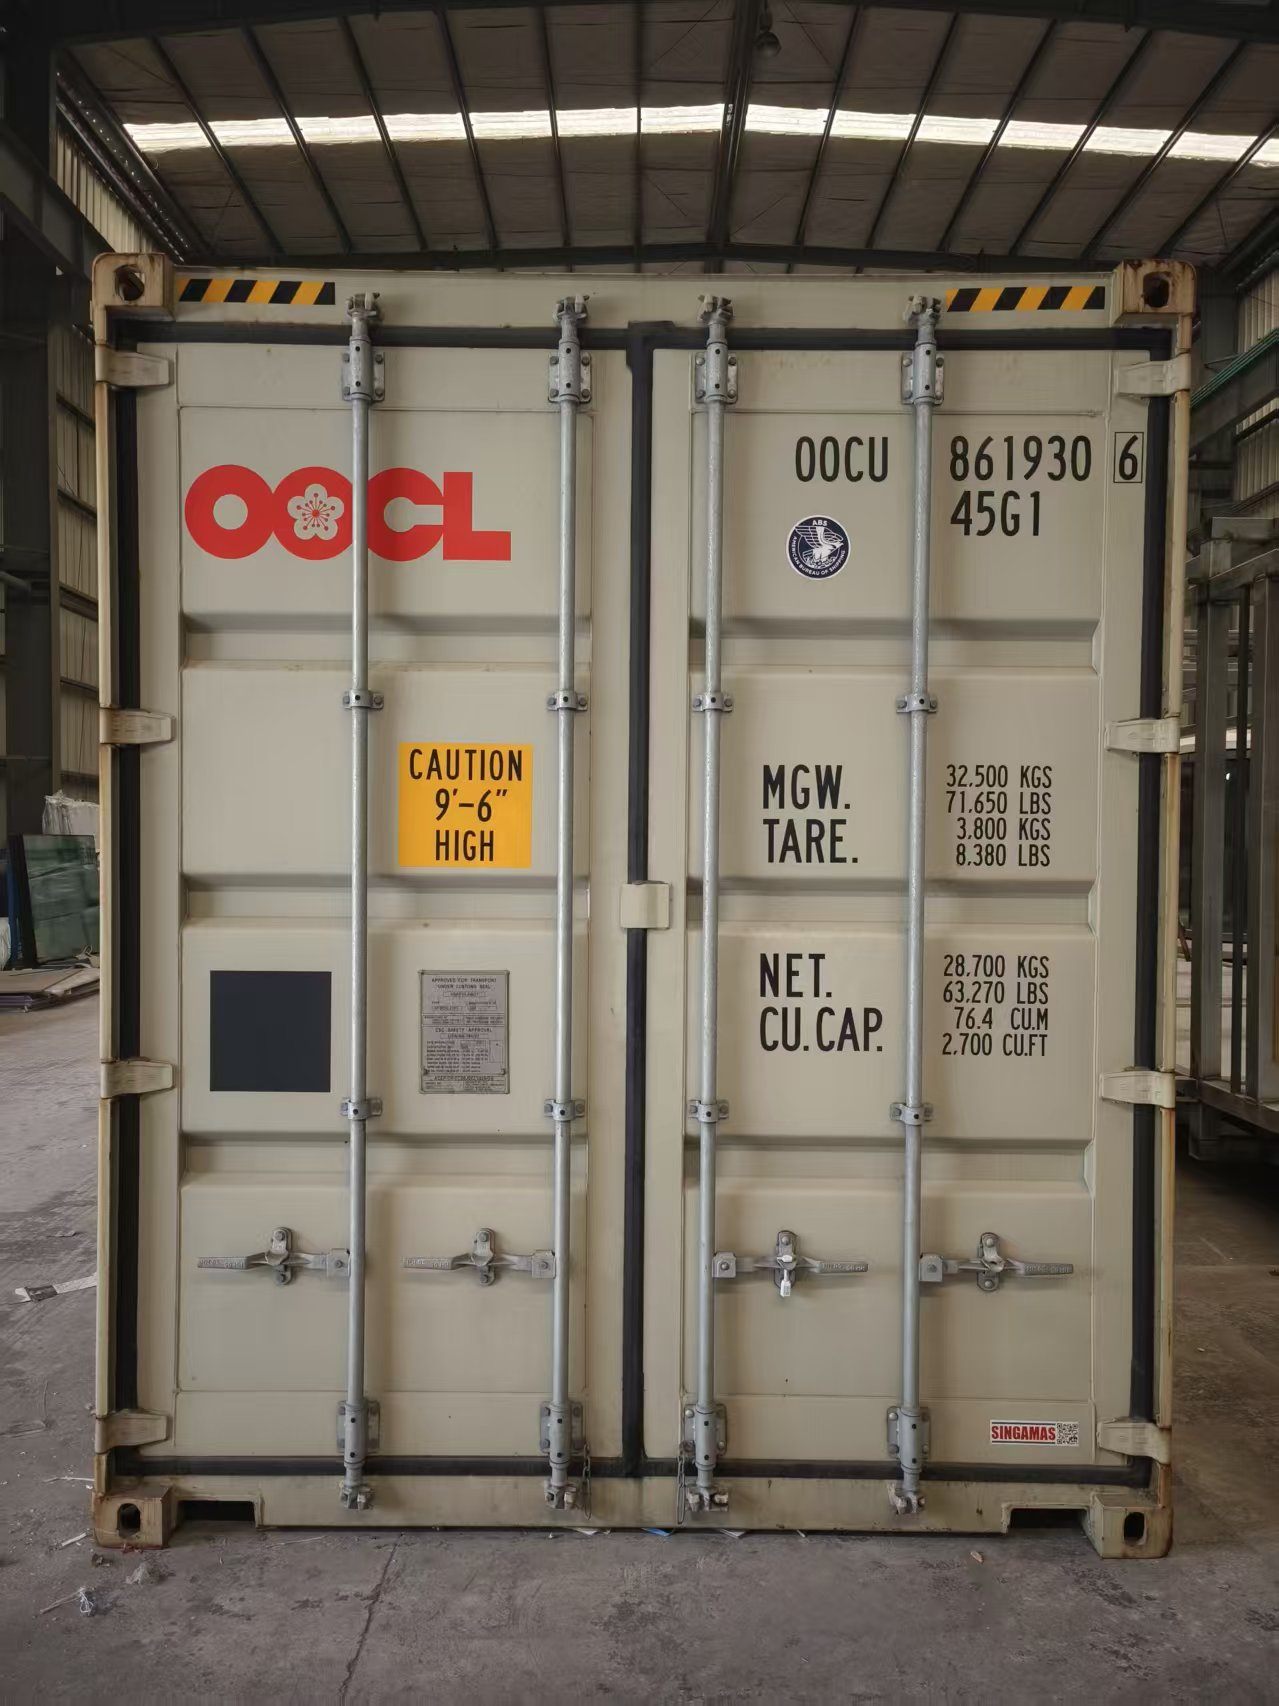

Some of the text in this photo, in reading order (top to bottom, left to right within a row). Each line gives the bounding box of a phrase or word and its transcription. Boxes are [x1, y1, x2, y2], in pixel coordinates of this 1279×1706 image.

[796, 434, 1139, 483] OOCU 861930 6
[185, 464, 511, 561] OOCL
[812, 519, 828, 527] ABS
[951, 490, 1041, 537] 45G1
[791, 536, 800, 565] AMERICAN
[798, 563, 820, 576] BUREAU
[829, 550, 846, 573] SHIPPING
[409, 748, 522, 781] CAUTION
[763, 764, 851, 810] MGW.
[1020, 765, 1053, 789] KGS
[1019, 791, 1052, 815] LBS
[435, 829, 494, 862] HIGH
[762, 818, 858, 864] TARE.
[1018, 817, 1051, 841] KGS
[1017, 843, 1051, 867] LBS
[760, 953, 832, 998] NET.
[1017, 955, 1049, 979] KGS
[1016, 981, 1049, 1005] LBS
[759, 1006, 1049, 1052] CU.CAP. 76.4 CU.M
[1002, 1033, 1048, 1057] CU.FT
[991, 1425, 1056, 1441] SINGAMAS
